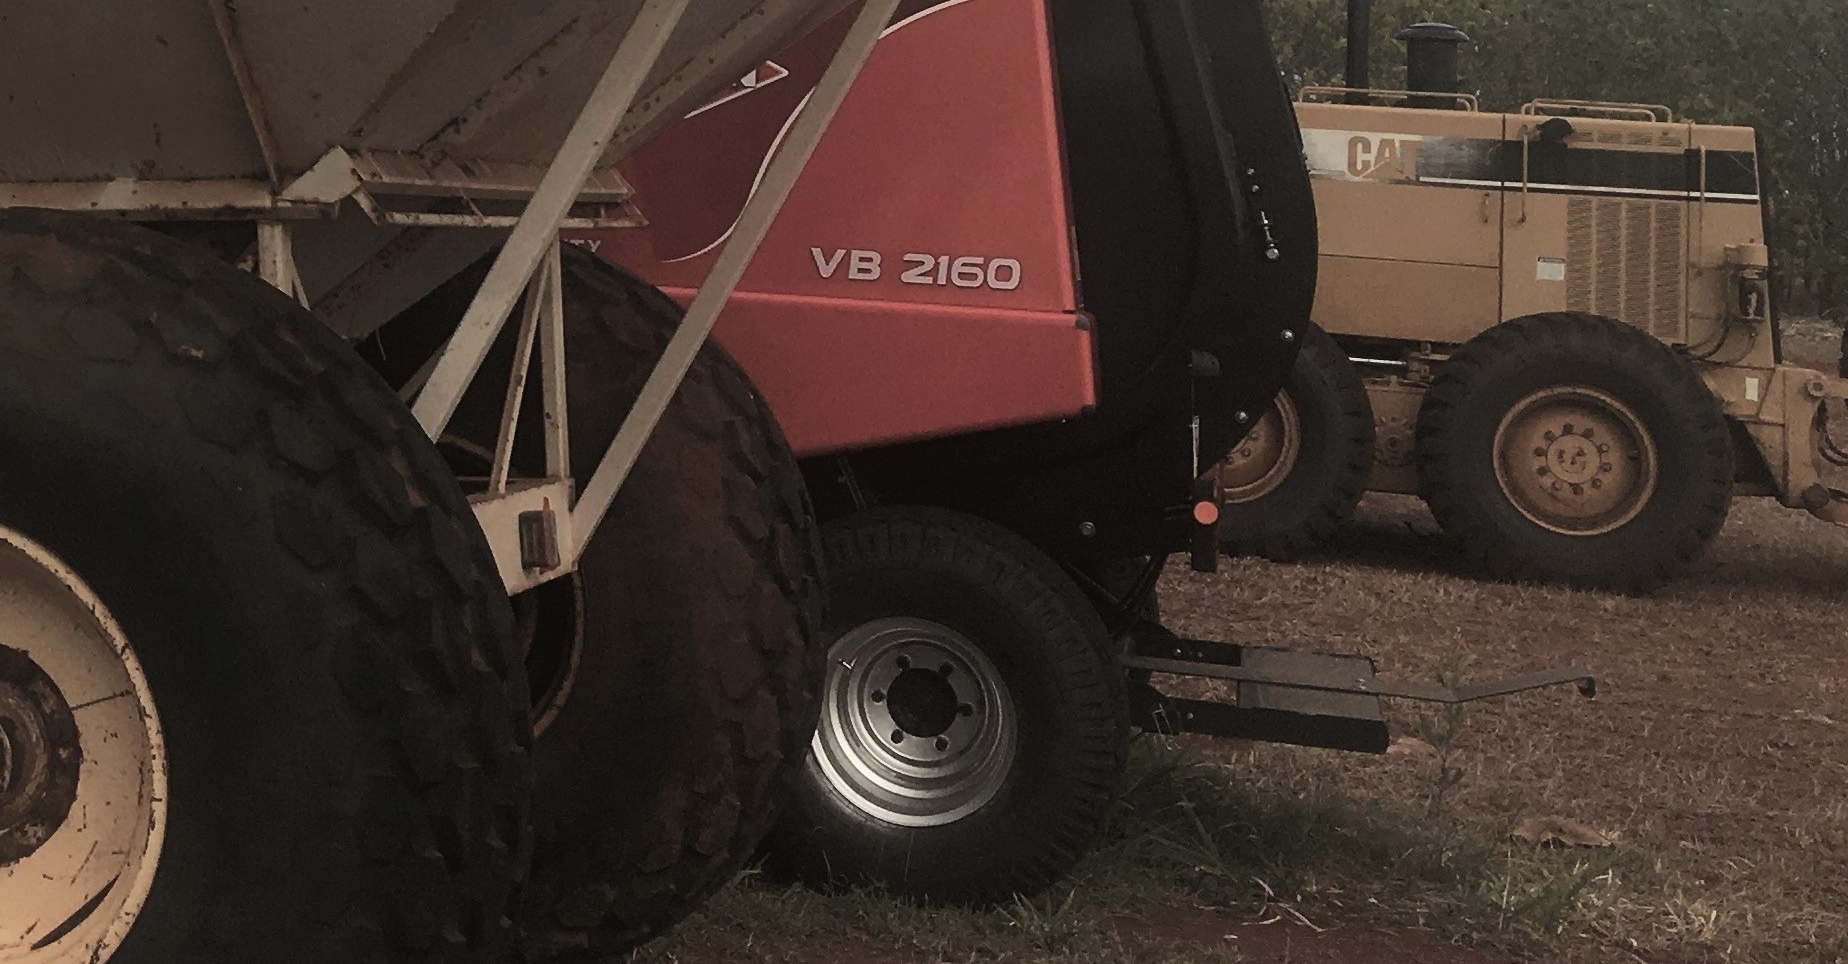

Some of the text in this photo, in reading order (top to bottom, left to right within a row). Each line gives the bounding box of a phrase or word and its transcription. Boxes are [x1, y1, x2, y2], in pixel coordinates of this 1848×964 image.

[1348, 136, 1422, 181] CAT
[810, 247, 1021, 290] VB 2160
